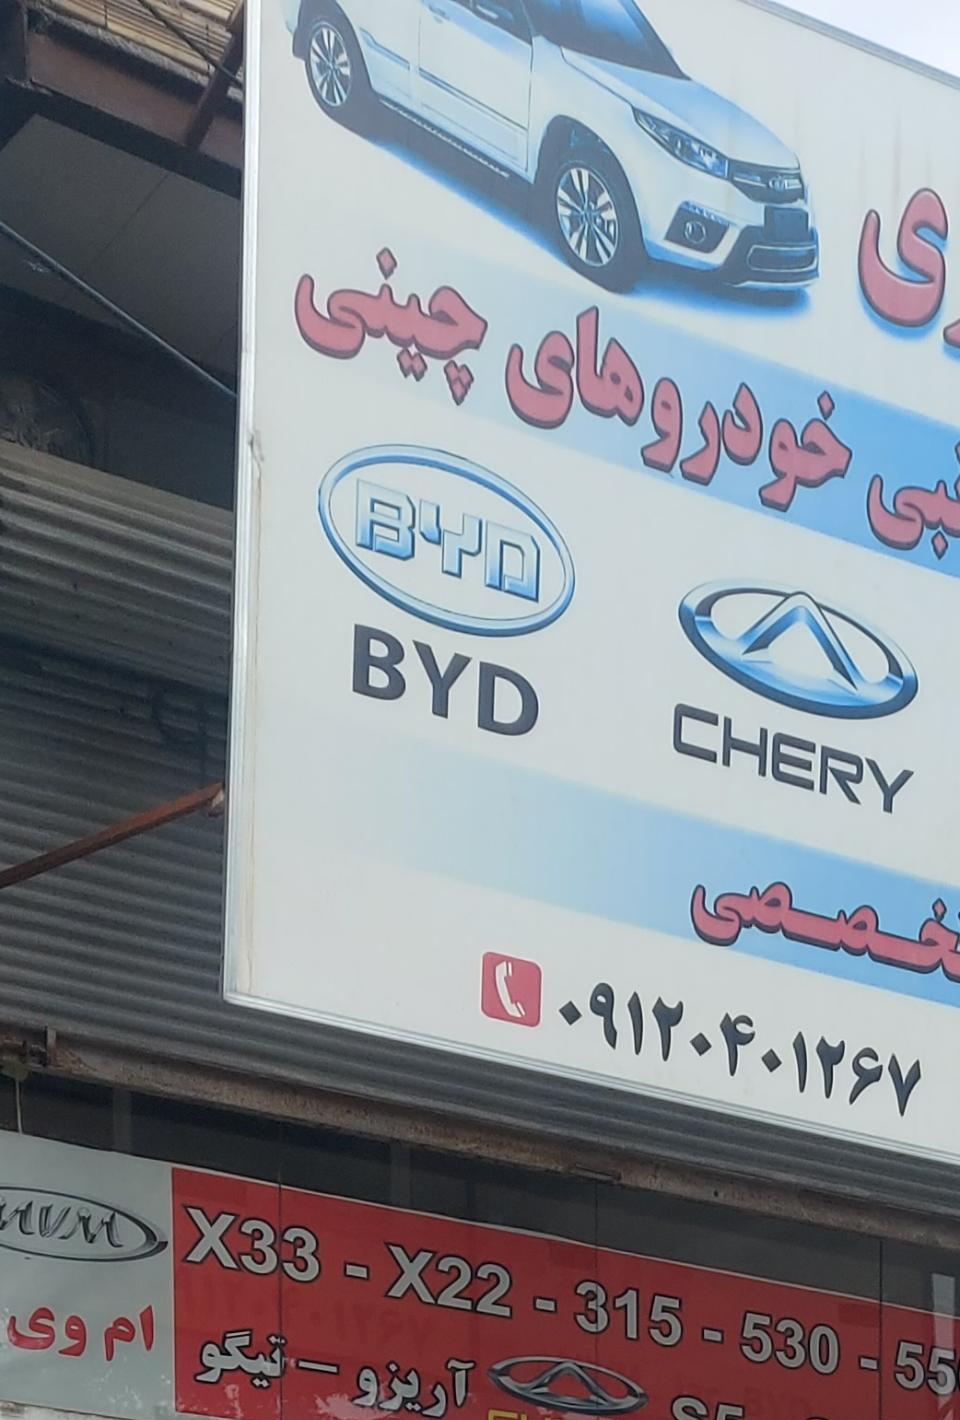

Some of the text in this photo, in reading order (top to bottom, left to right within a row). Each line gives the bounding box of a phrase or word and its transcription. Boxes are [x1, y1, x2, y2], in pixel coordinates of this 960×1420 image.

[294, 246, 488, 407] چینی
[504, 304, 854, 513] خودروهای
[355, 479, 541, 603] BYD
[351, 623, 540, 737] BYD
[672, 702, 916, 815] CHERY
[557, 981, 922, 1118] ۰۹۱۲۰۴۰۱۲۶۷
[7, 1304, 155, 1362] ام وی
[183, 1206, 321, 1282] X33
[385, 1242, 513, 1318] X22
[573, 1279, 684, 1347] 315
[740, 1311, 840, 1374] 530
[195, 1329, 287, 1388] تیگو
[352, 1358, 475, 1418] آریزو
